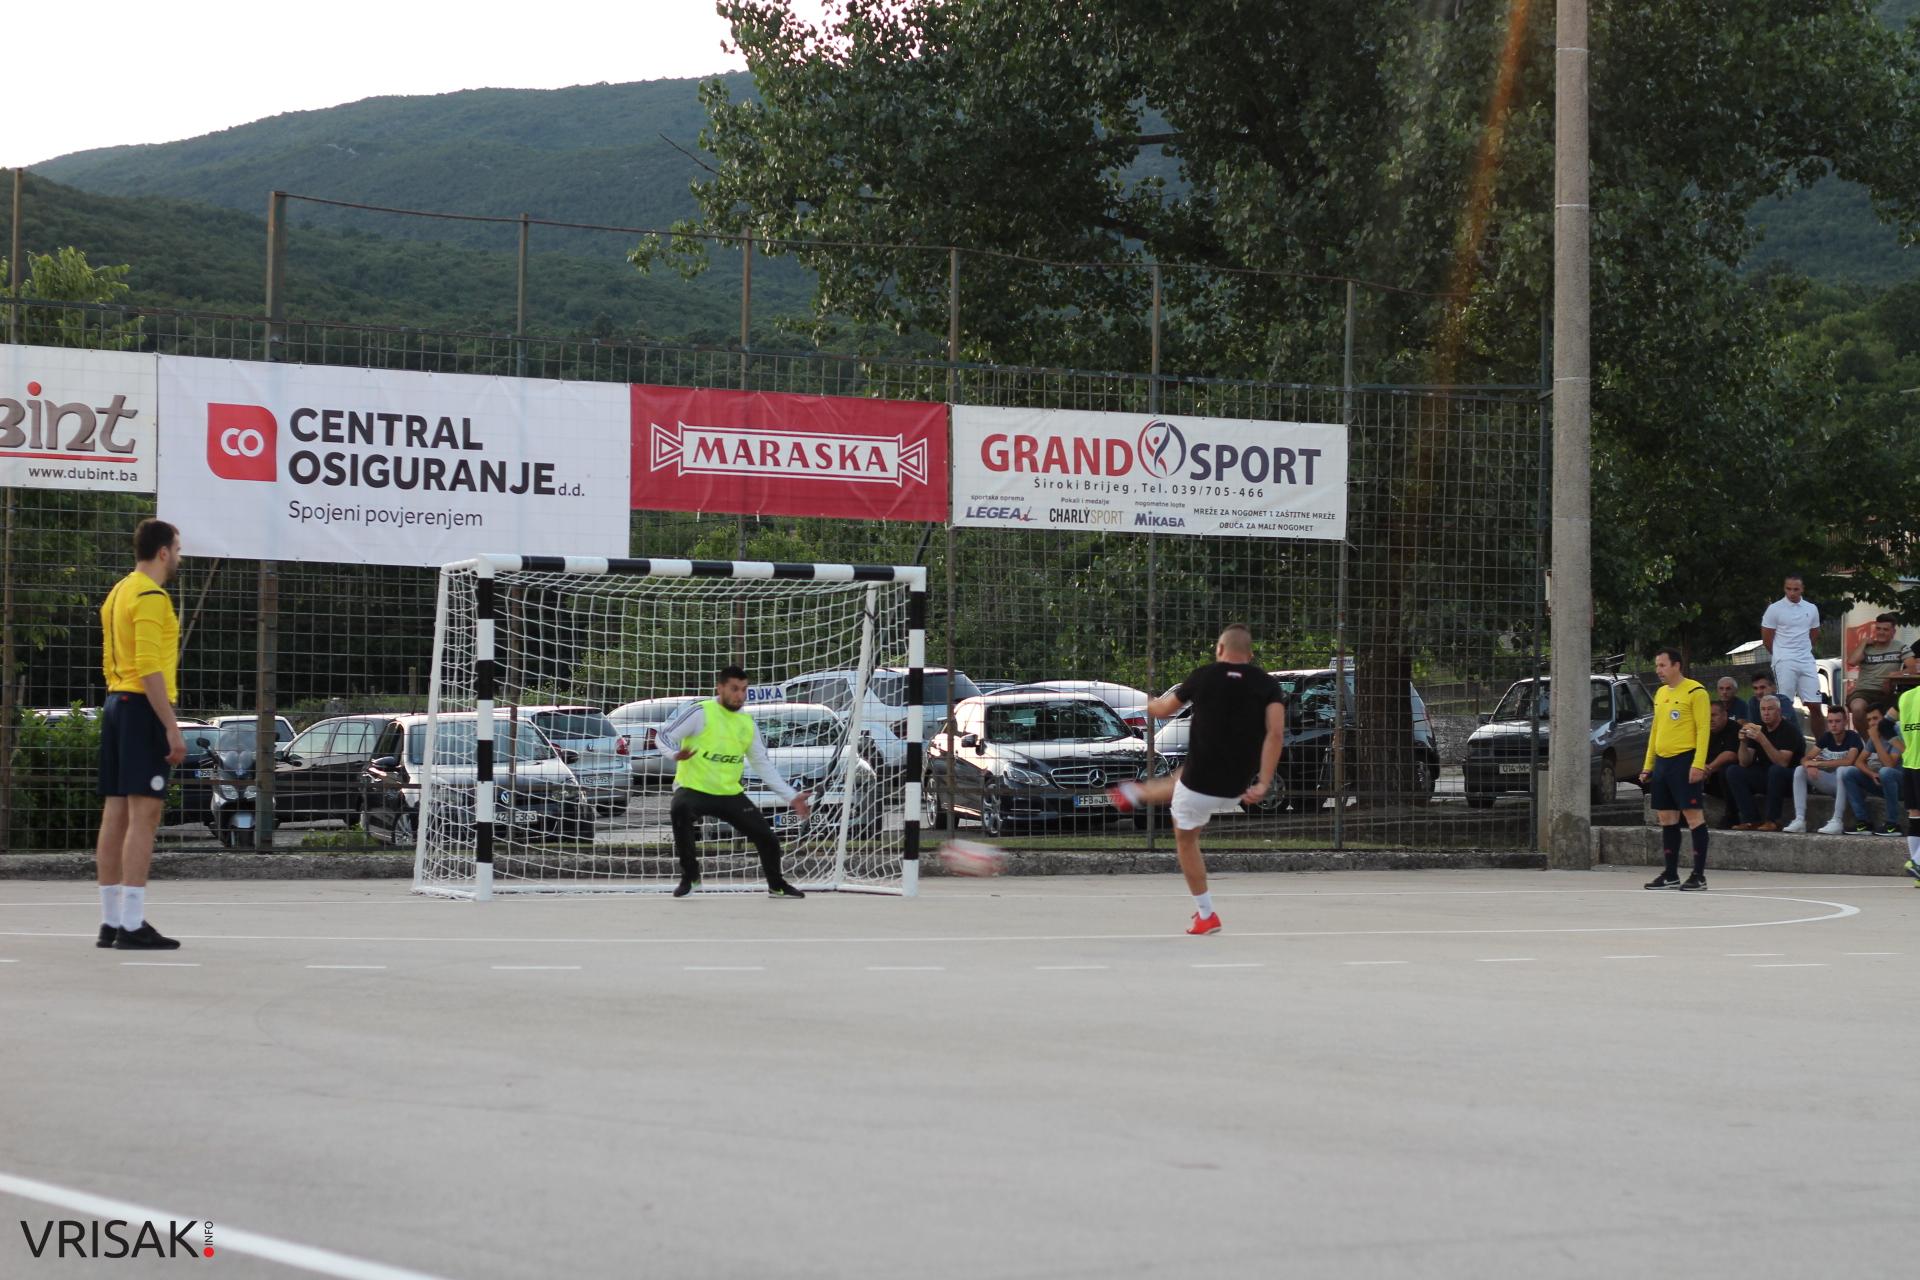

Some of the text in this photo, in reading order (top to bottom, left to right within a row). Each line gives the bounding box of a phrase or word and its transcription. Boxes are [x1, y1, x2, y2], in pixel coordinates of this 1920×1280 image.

[290, 407, 484, 450] CENTRAL
[220, 427, 265, 457] CO
[693, 436, 888, 473] MARASKA
[980, 433, 1321, 485] GRAND SPORT
[28, 467, 138, 482] www.dubint.ba
[288, 450, 556, 495] OSIGURANJE
[1172, 484, 1264, 498] 039/705-466
[1085, 498, 1110, 506] medalje
[1135, 500, 1169, 508] nogometne
[288, 500, 483, 529] Spojeni povjerenjem
[966, 506, 1021, 519] LEGEA
[1193, 507, 1218, 516] MREŽE
[1220, 508, 1230, 516] ZA
[1231, 509, 1267, 517] NOGOMET
[1246, 522, 1256, 530] ZA
[1258, 523, 1276, 531] MALI
[1277, 523, 1314, 532] NOGOMET
